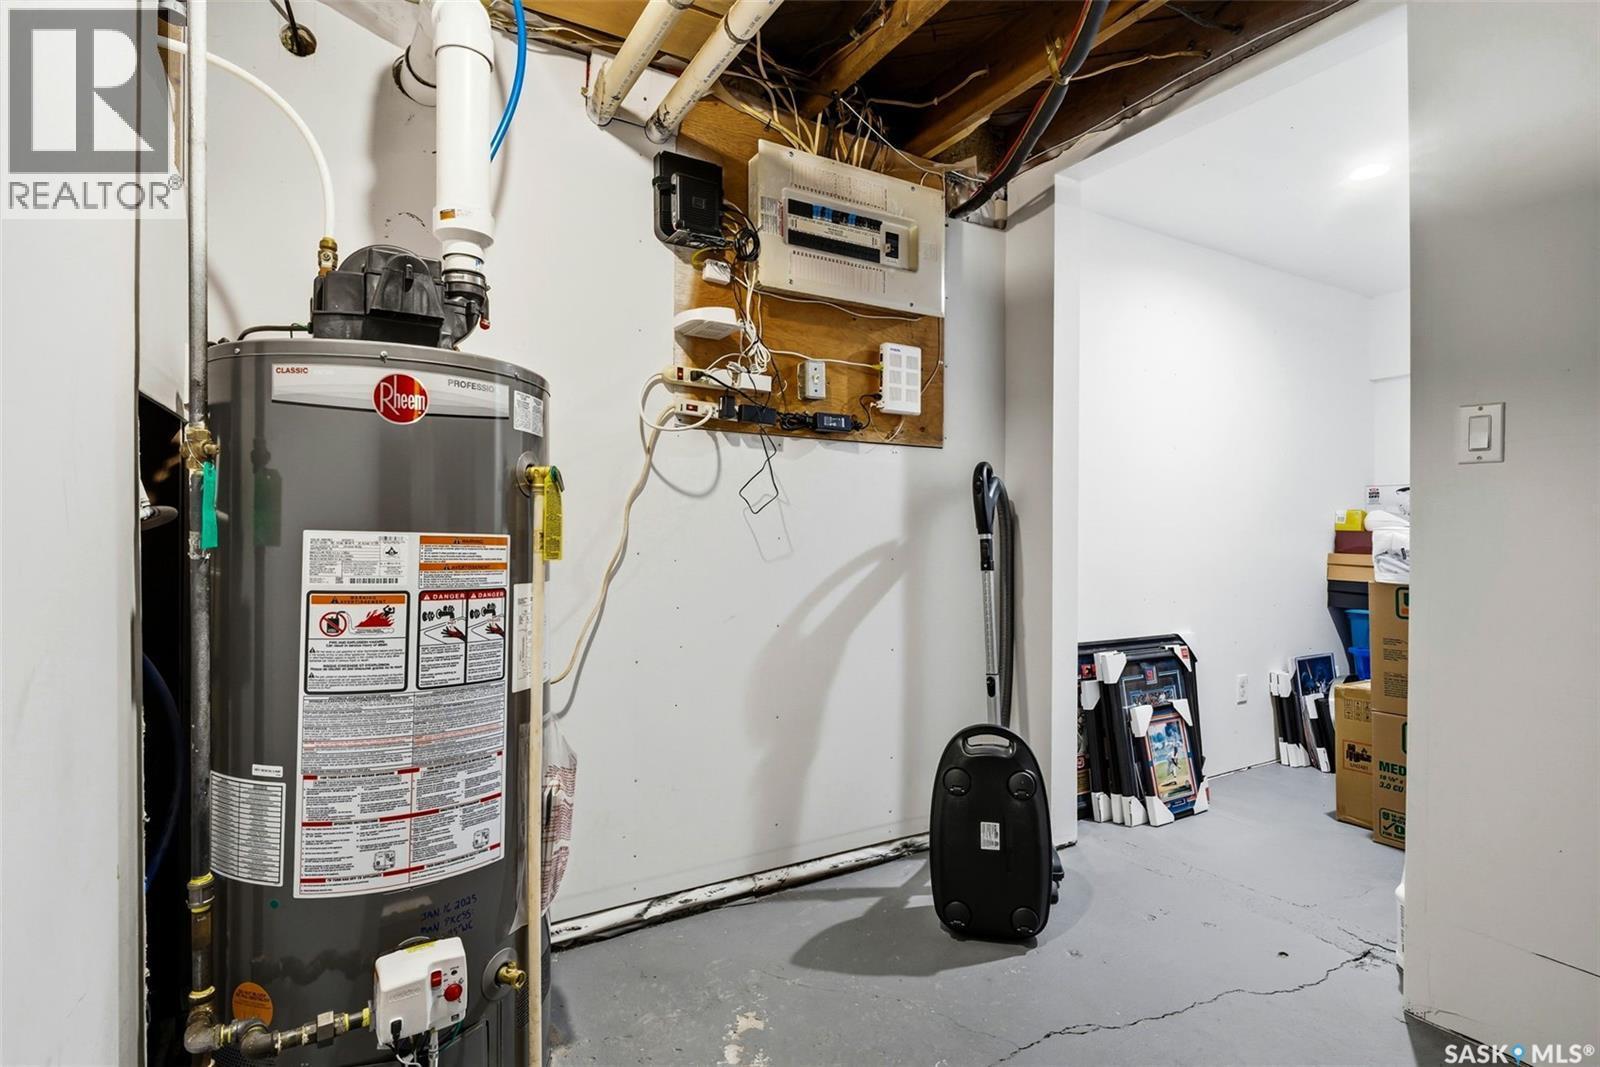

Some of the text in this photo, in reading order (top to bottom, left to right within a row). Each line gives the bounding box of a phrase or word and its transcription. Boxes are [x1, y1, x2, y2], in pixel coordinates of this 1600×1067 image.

[275, 367, 309, 375] CLASSIC
[379, 375, 426, 415] Rheem
[1392, 784, 1404, 793] CU
[454, 893, 479, 911] 2025
